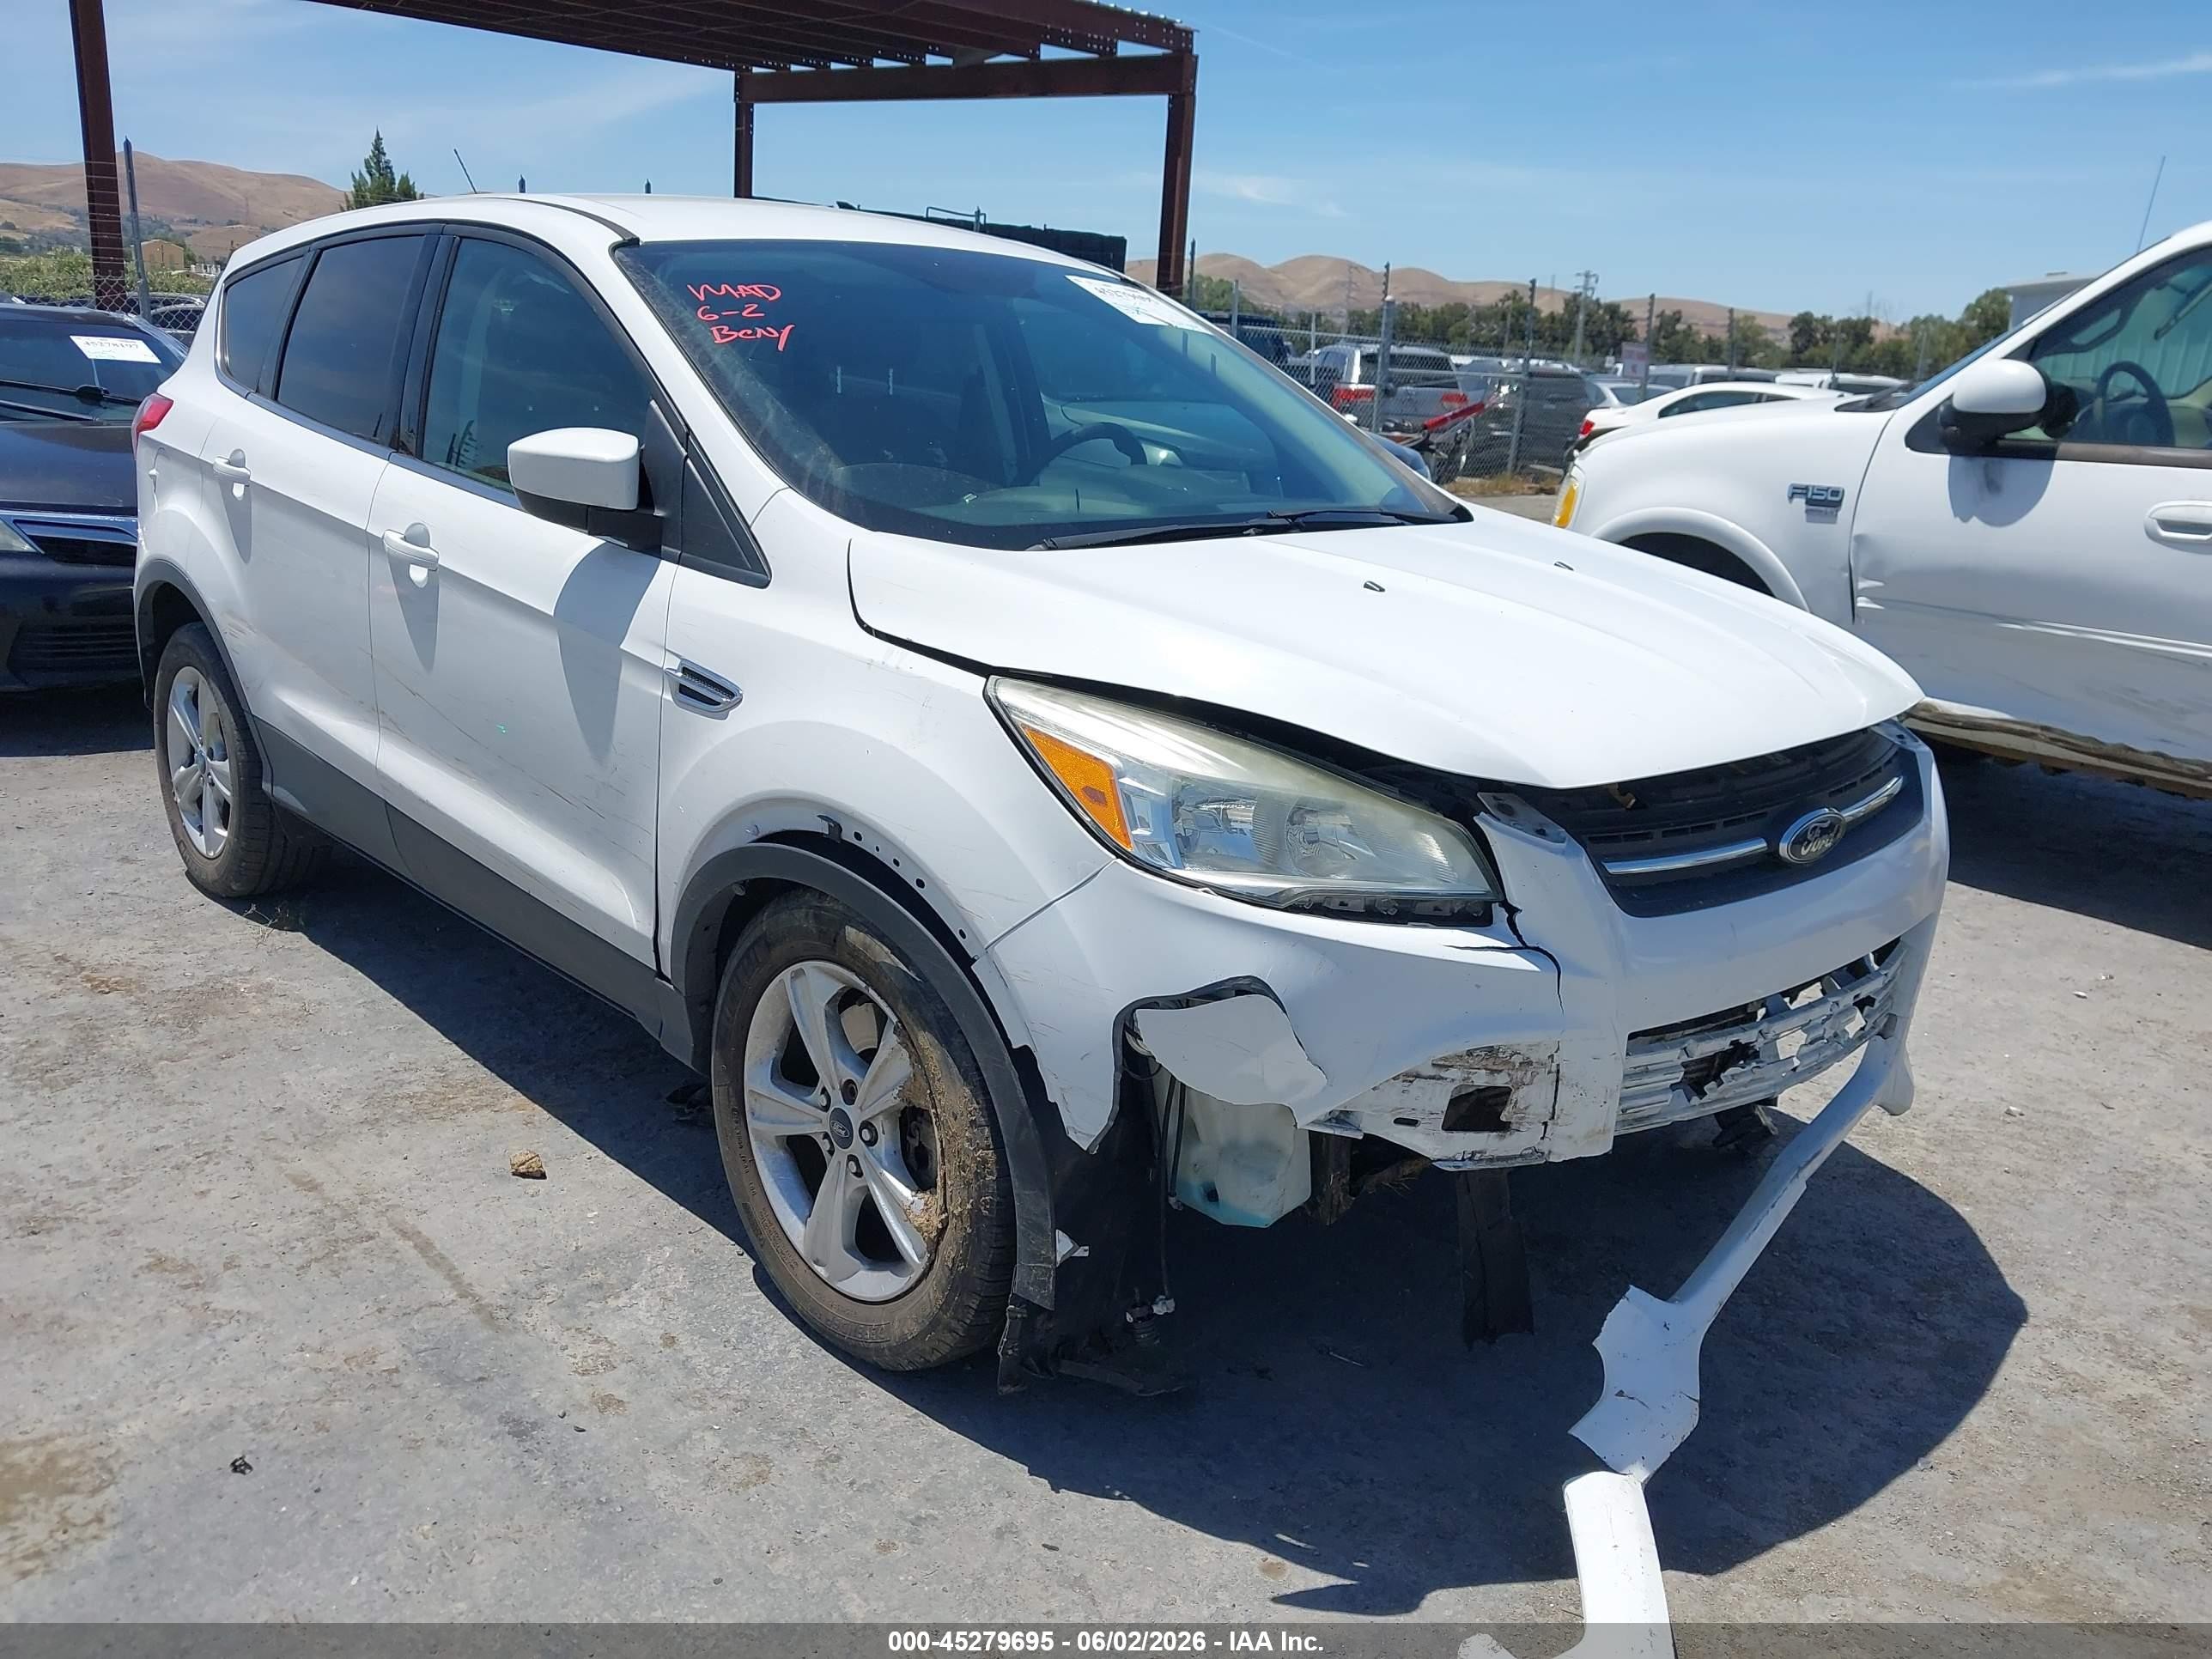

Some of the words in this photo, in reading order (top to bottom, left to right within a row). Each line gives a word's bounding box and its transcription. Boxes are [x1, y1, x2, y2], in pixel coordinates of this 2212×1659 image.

[696, 303, 766, 321] 6-2
[1800, 818, 1843, 856] Ford
[833, 1122, 847, 1135] Ford
